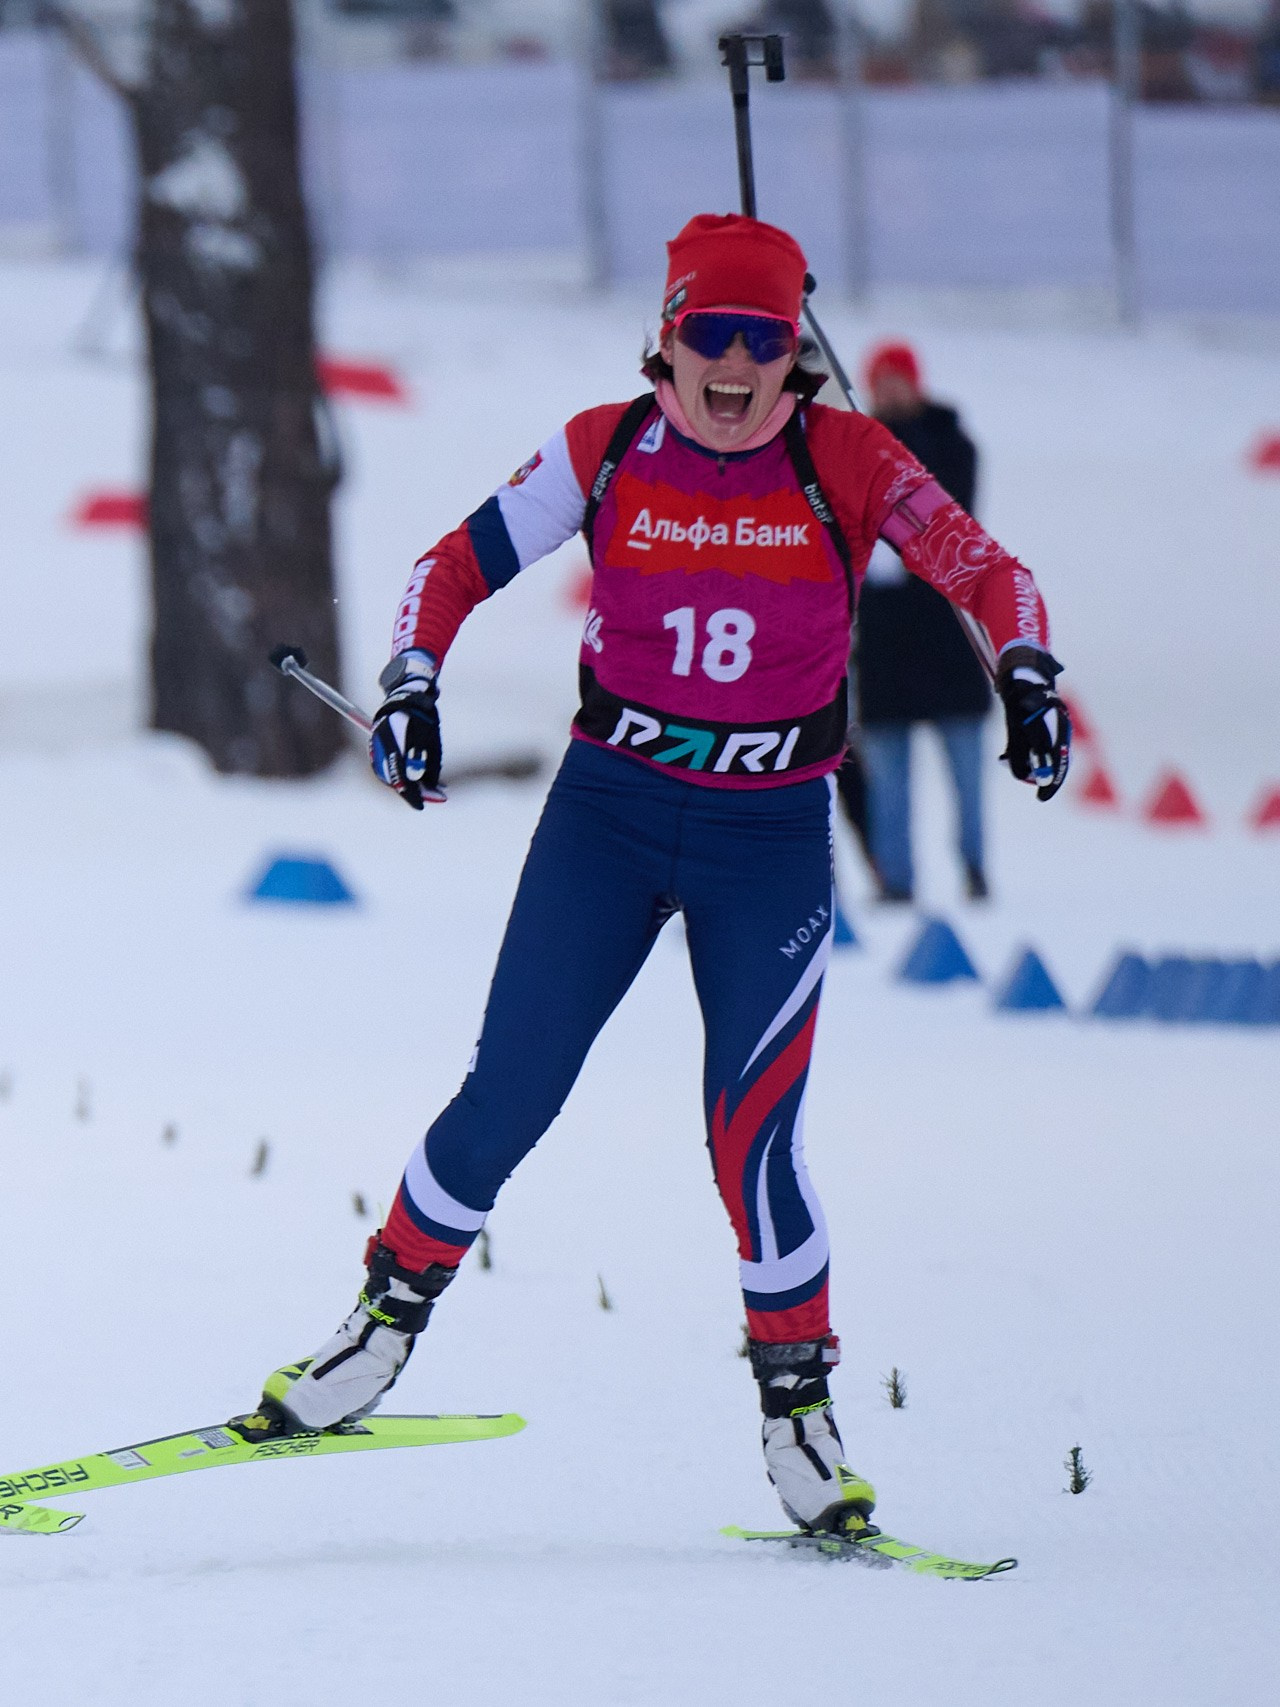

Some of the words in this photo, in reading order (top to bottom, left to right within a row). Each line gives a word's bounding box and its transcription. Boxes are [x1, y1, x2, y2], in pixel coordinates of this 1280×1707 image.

[803, 483, 835, 525] biatar
[629, 508, 728, 550] Альфа
[735, 517, 810, 547] Банк
[663, 606, 756, 683] 18
[606, 707, 801, 773] PARI
[779, 905, 829, 960] MOAX
[249, 1439, 320, 1459] FISCHER
